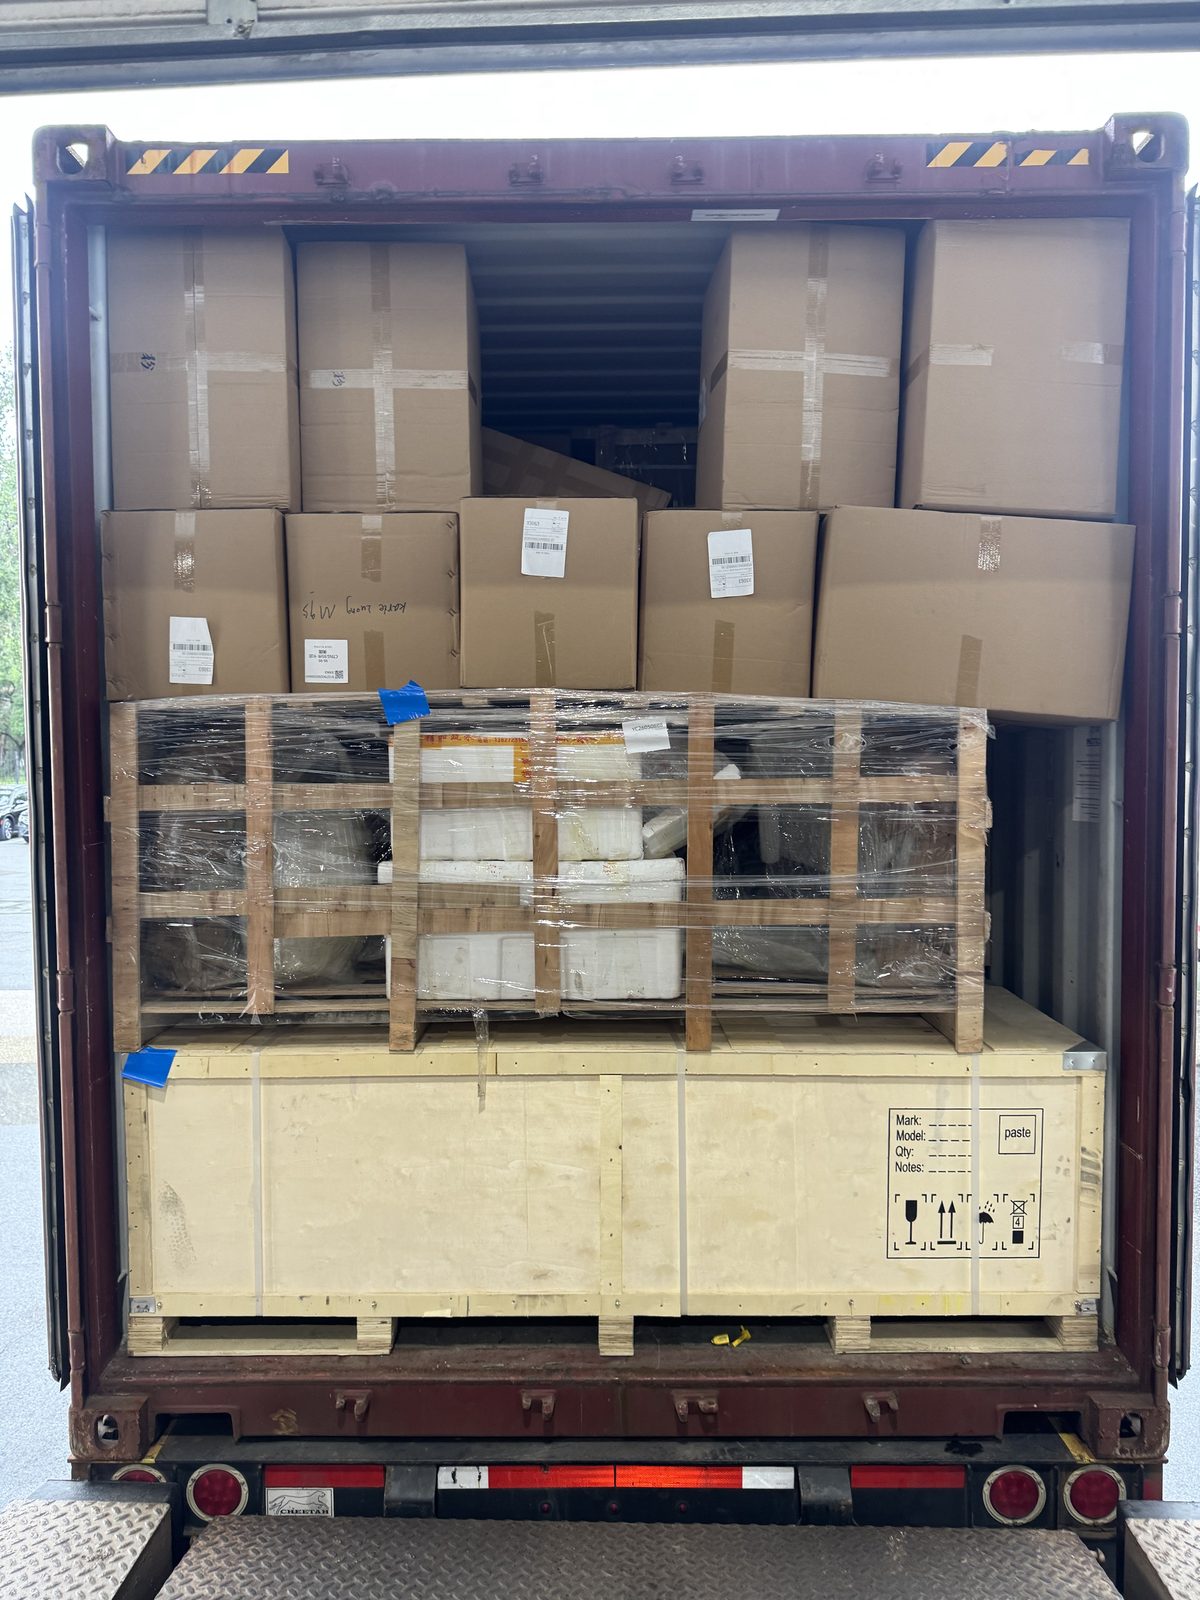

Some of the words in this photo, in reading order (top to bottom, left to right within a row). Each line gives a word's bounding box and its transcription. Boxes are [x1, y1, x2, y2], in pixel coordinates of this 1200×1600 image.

[896, 1114, 922, 1126] Mark:
[896, 1130, 926, 1142] Model:
[1004, 1127, 1032, 1140] paste
[895, 1146, 914, 1158] Qty:
[895, 1162, 925, 1173] Notes:
[1015, 1218, 1021, 1227] 4
